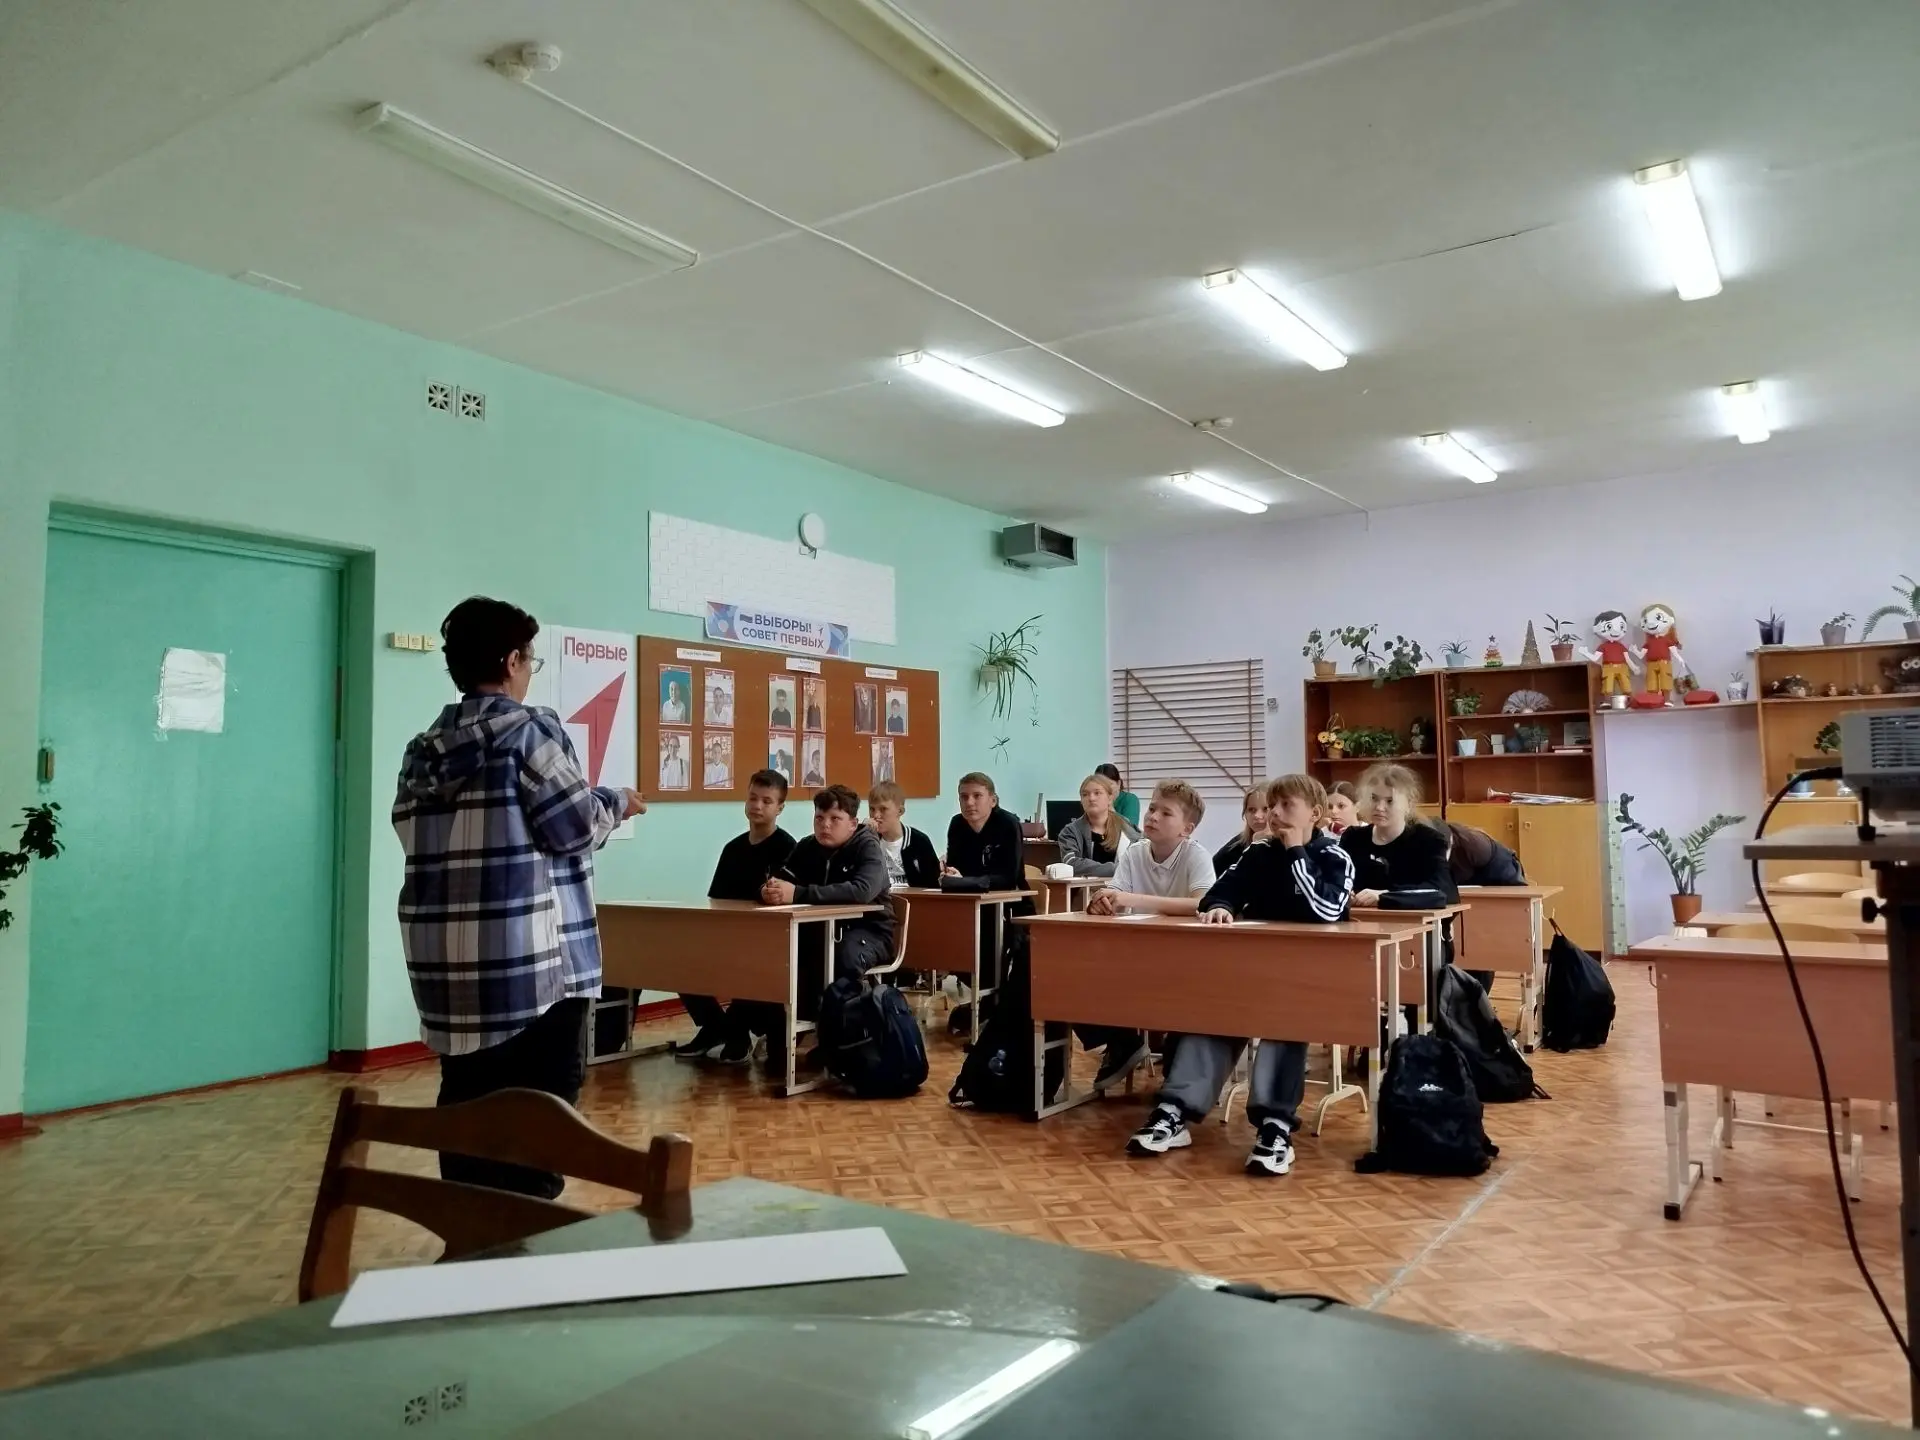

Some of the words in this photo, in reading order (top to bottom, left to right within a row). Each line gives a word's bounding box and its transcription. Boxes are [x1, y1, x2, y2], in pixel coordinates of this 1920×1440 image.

[754, 614, 812, 633] ВЫБОРЫ!
[741, 627, 778, 641] СОВЕТ
[780, 633, 824, 649] ПЕРВЫХ
[564, 636, 628, 664] Первые
